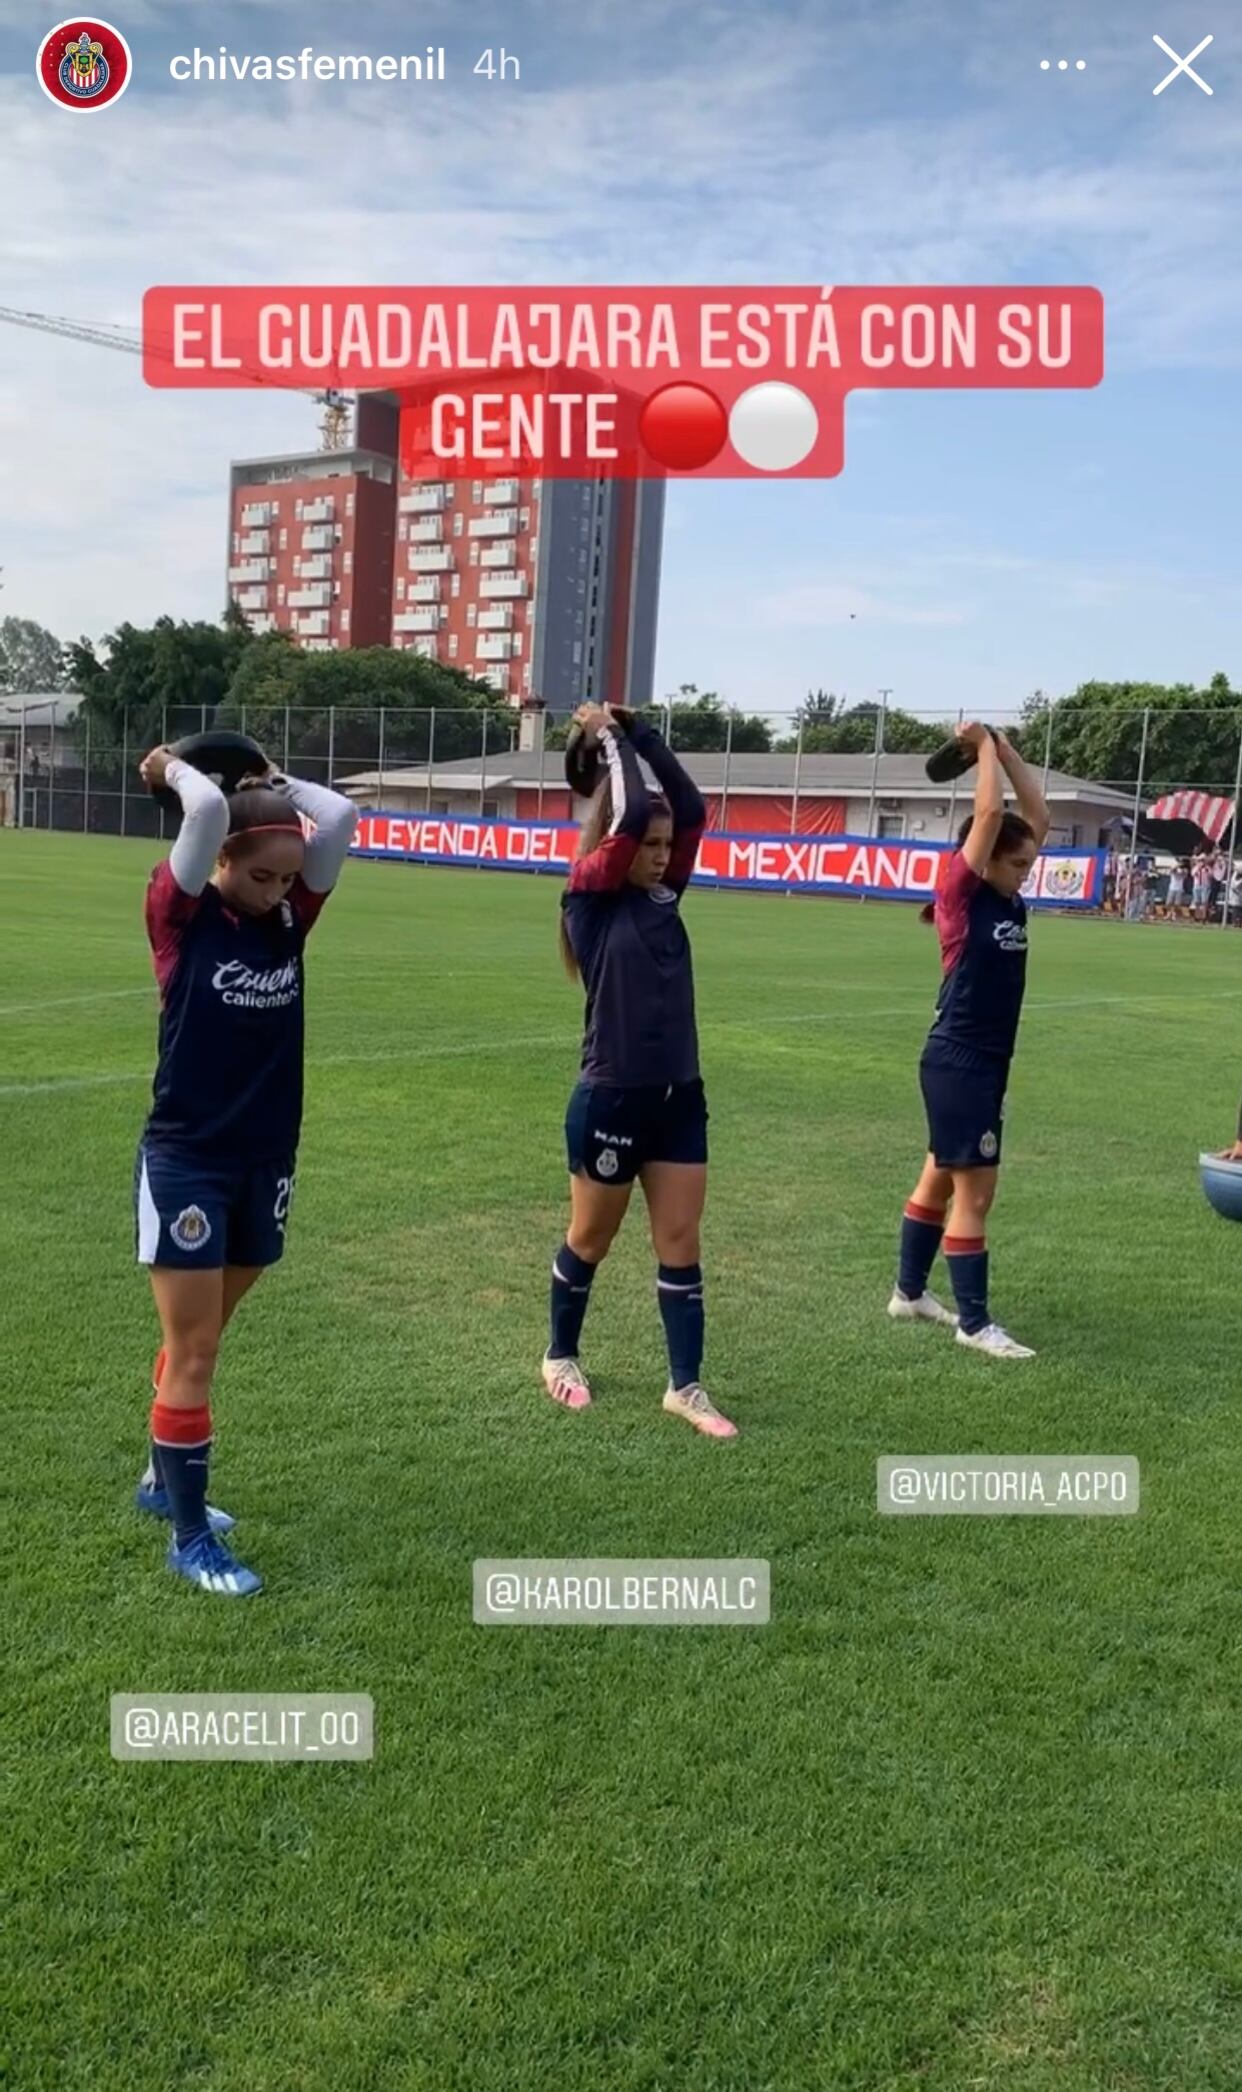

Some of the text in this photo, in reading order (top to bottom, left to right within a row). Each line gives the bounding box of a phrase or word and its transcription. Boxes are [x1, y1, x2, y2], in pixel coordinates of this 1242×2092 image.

[367, 817, 498, 859] LEYENDA
[506, 826, 570, 863] DEL
[728, 840, 940, 891] MEXICANO
